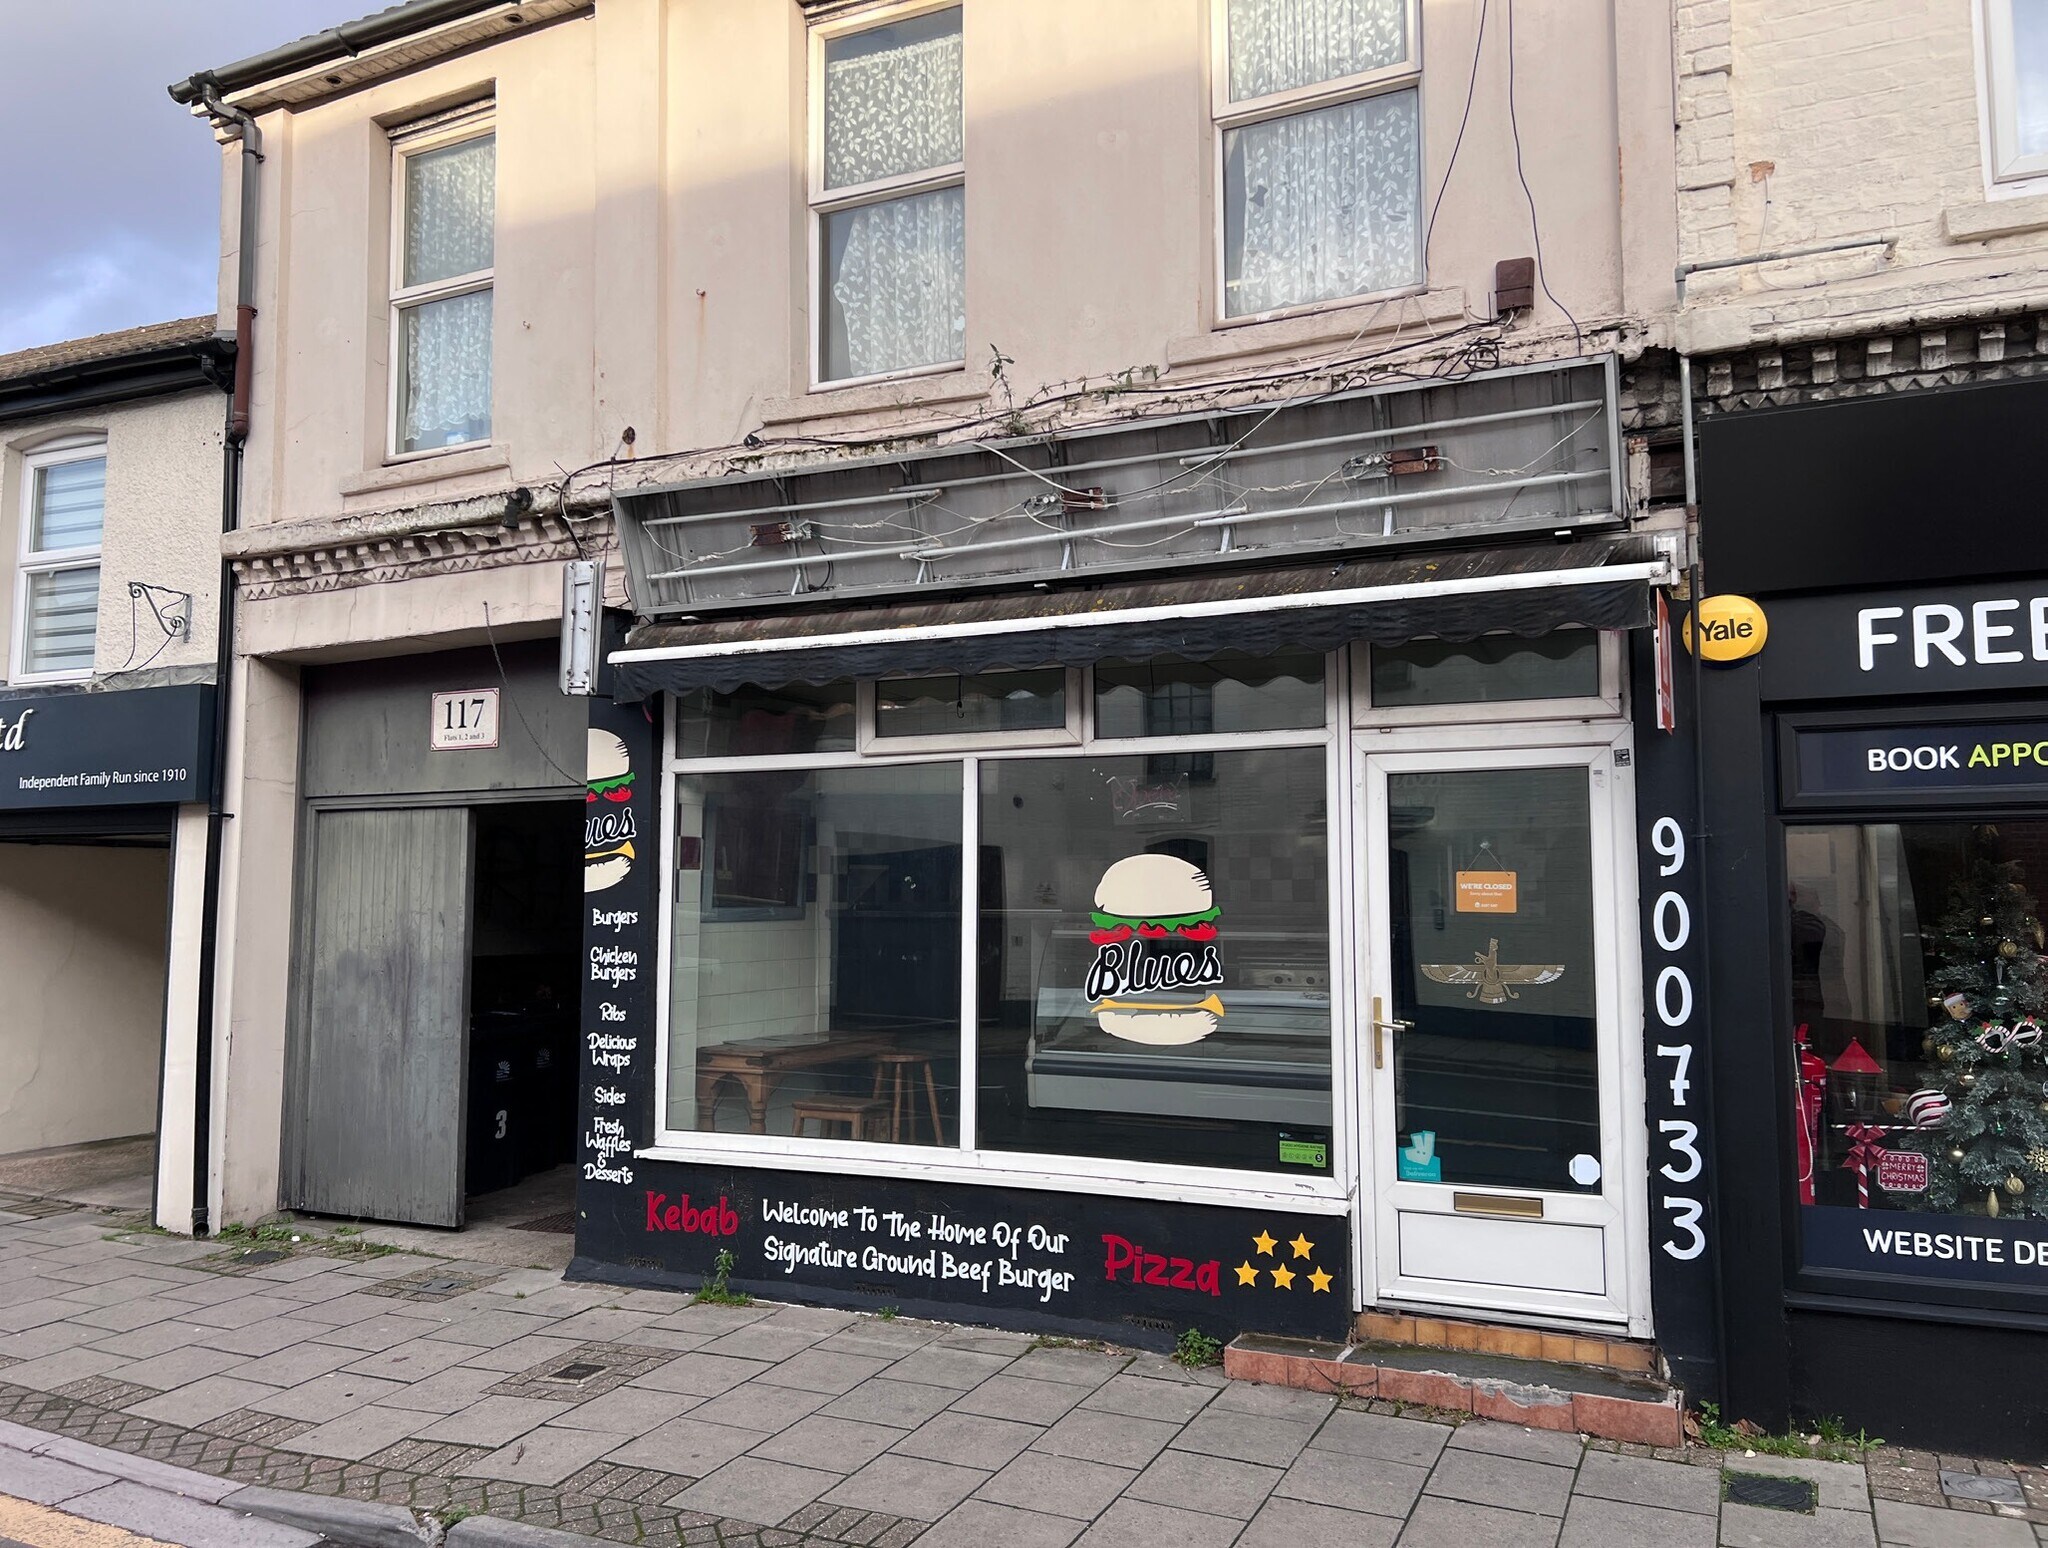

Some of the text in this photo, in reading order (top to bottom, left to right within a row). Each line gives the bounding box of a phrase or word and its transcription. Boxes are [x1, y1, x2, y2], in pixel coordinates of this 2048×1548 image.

[1699, 618, 1753, 642] Yale
[444, 698, 486, 730] 117
[1867, 745, 1960, 772] BOOK
[19, 768, 187, 791] Independent Family Run since 1910
[592, 908, 639, 933] Burgers
[590, 946, 638, 965] Chicken
[591, 963, 637, 988] Burgers
[1085, 940, 1224, 1003] Blues
[599, 1002, 627, 1022] Ribs
[587, 1032, 637, 1050] Delicious
[592, 1050, 631, 1074] Wraps
[594, 1086, 627, 1106] Sides
[495, 1110, 507, 1139] 3
[594, 1117, 624, 1138] Fresh
[585, 1131, 632, 1158] Waffles
[597, 1151, 607, 1169] &
[1889, 1162, 1915, 1171] MERRY
[583, 1163, 634, 1185] Desserts
[1881, 1171, 1925, 1182] CHRISTMAS
[646, 1190, 739, 1237] Kebab
[762, 1198, 1070, 1260] Welcome To The Home Of Our
[1862, 1228, 2048, 1266] WEBSITE DE
[763, 1235, 1075, 1302] Signature Ground Beef Burger
[1101, 1234, 1221, 1296] Pizza
